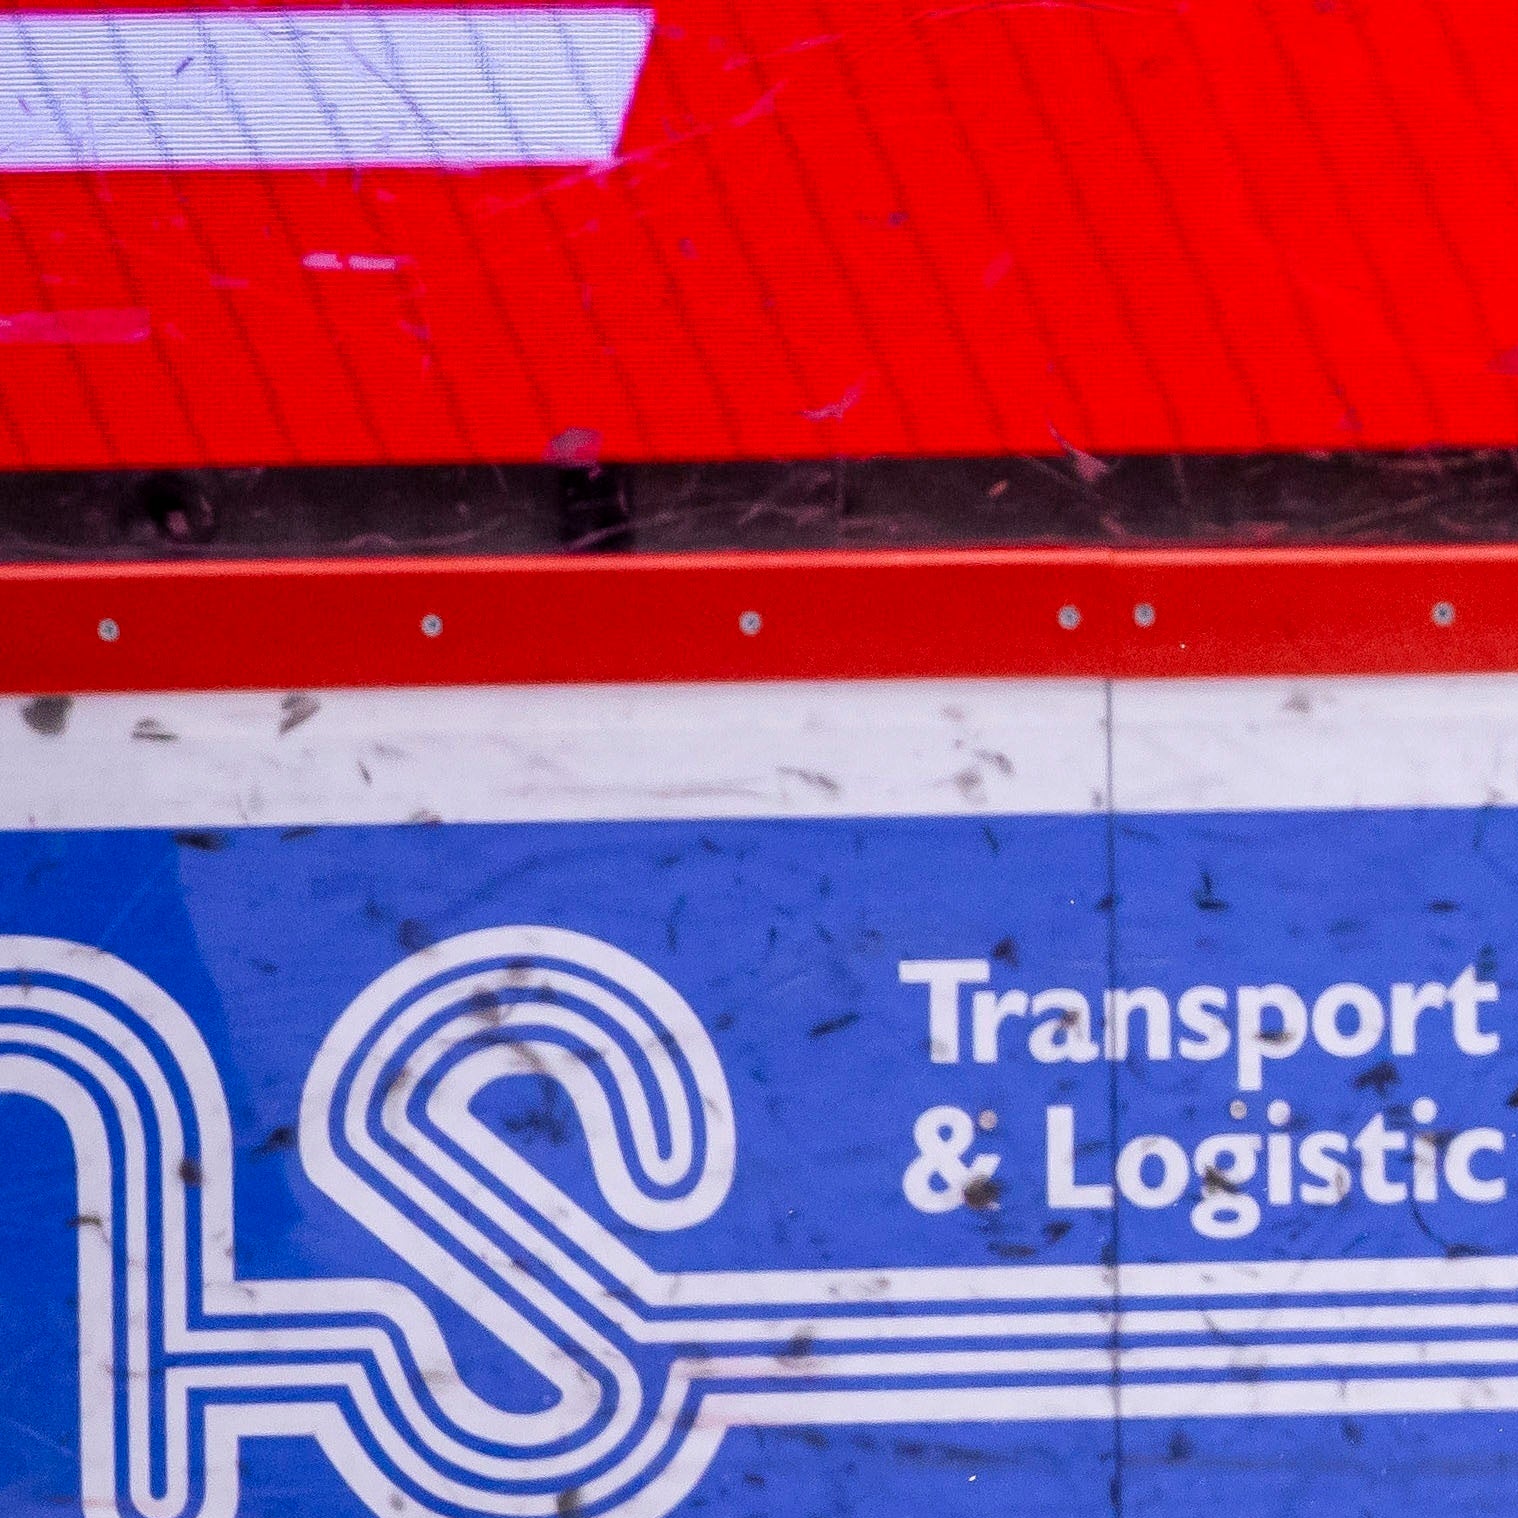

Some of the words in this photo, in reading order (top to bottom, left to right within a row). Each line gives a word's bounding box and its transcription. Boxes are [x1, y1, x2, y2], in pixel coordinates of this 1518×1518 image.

[898, 959, 1500, 1090] Transport
[903, 1105, 1000, 1213] &
[1046, 1099, 1508, 1239] Logistic
